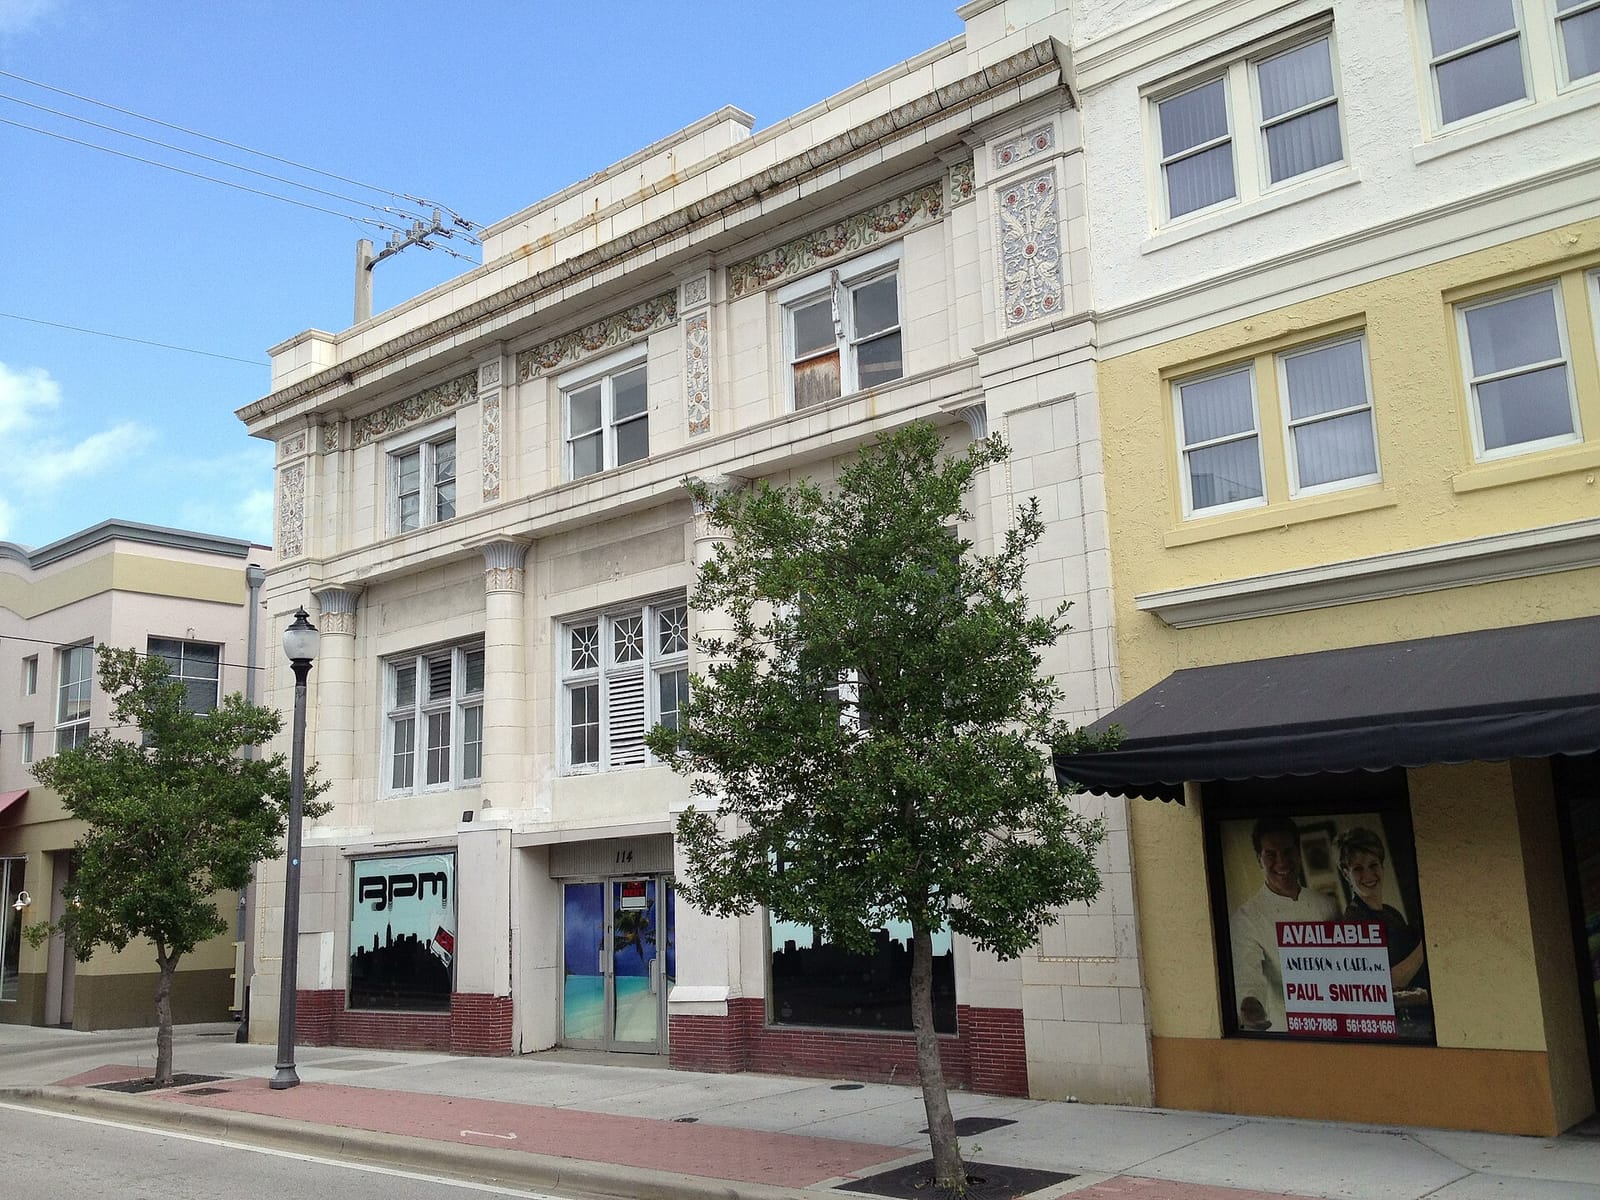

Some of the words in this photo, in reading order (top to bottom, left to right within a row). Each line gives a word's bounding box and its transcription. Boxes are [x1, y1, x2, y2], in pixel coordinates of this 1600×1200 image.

[615, 850, 634, 864] 114
[1282, 924, 1382, 945] AVAILABLE
[1286, 957, 1333, 971] ANDERSON
[1286, 983, 1324, 1001] PAUL
[1328, 983, 1388, 1003] SNITKIN
[1345, 1019, 1396, 1034] 561-833-1661
